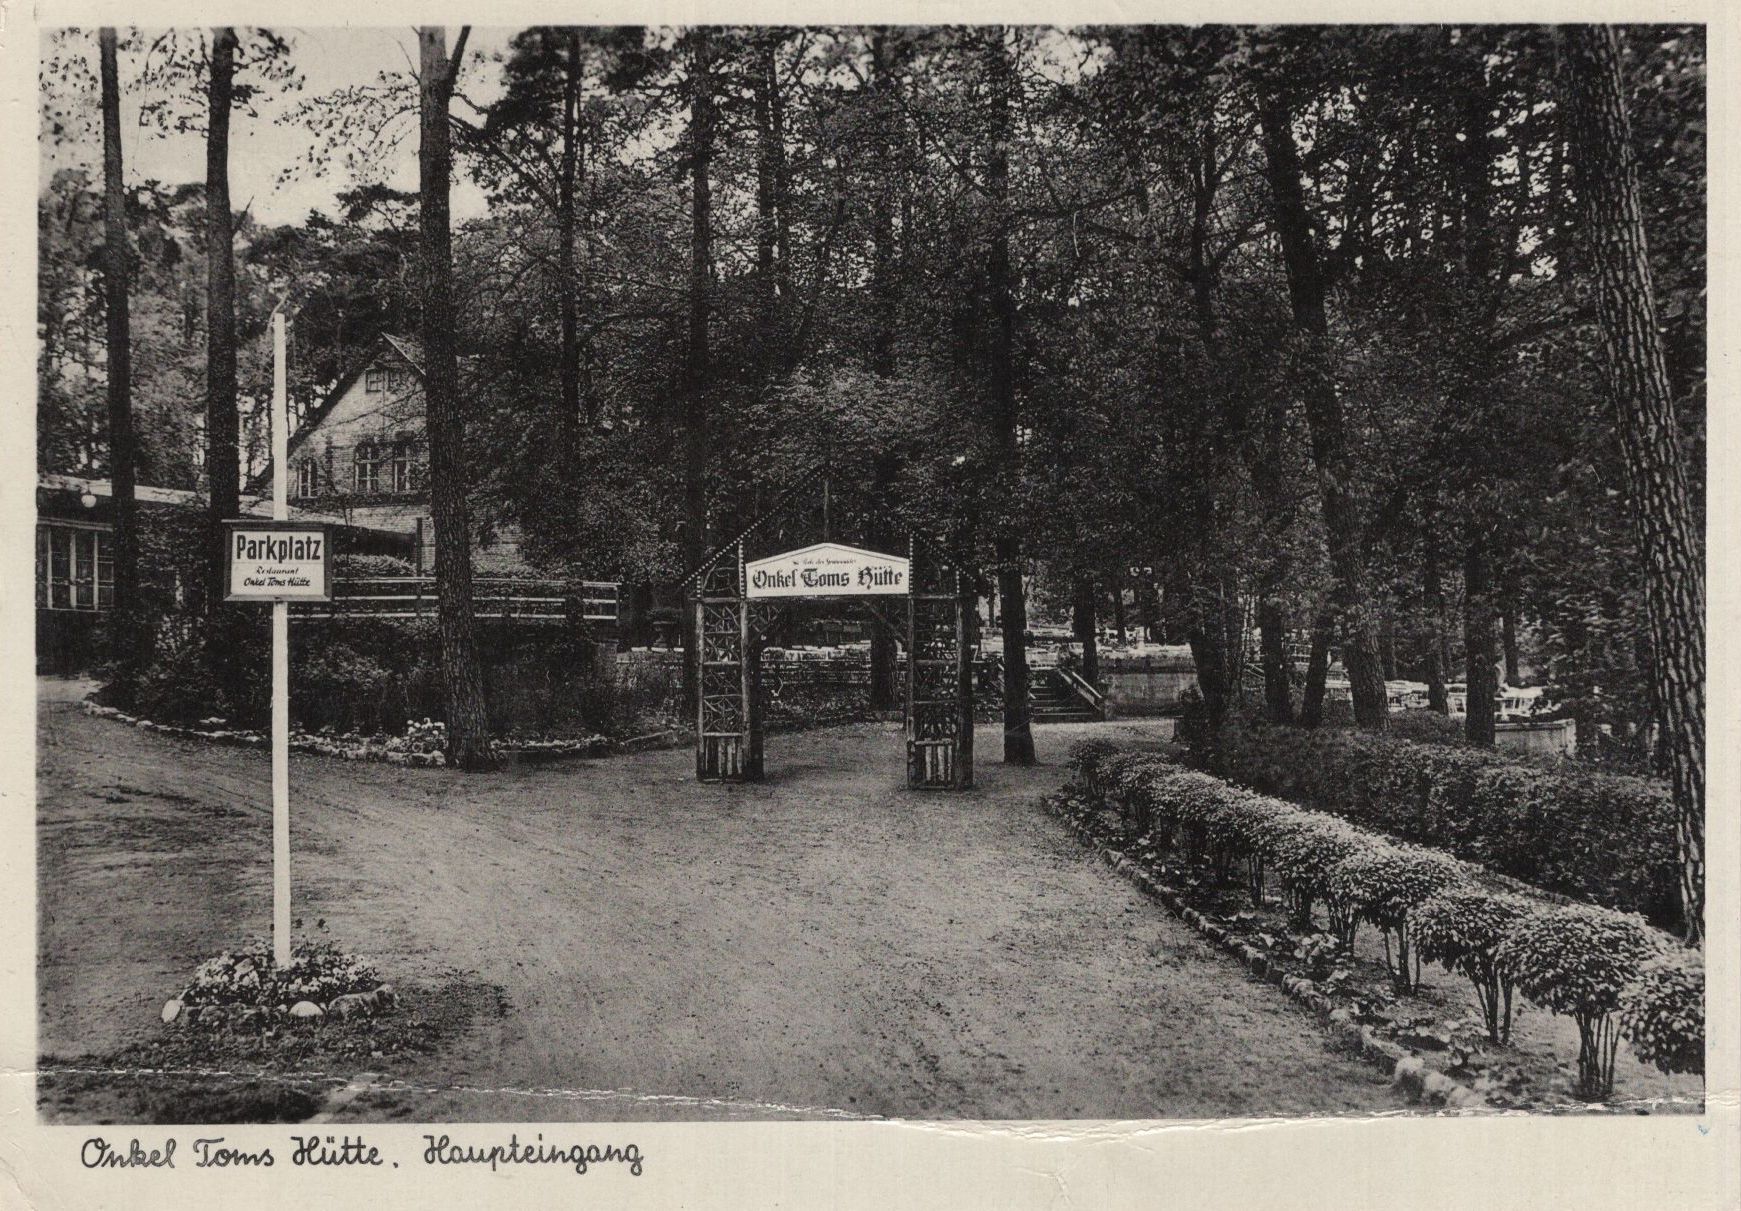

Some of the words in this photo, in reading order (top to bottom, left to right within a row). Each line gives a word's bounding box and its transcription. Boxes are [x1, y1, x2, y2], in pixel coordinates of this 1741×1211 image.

[236, 535, 321, 563] Parkplatz
[243, 578, 266, 587] Onkel
[267, 577, 287, 587] Toms
[287, 578, 311, 587] Hütte
[752, 569, 798, 589] Onkel
[800, 568, 850, 588] Toms
[857, 565, 903, 590] Hütte
